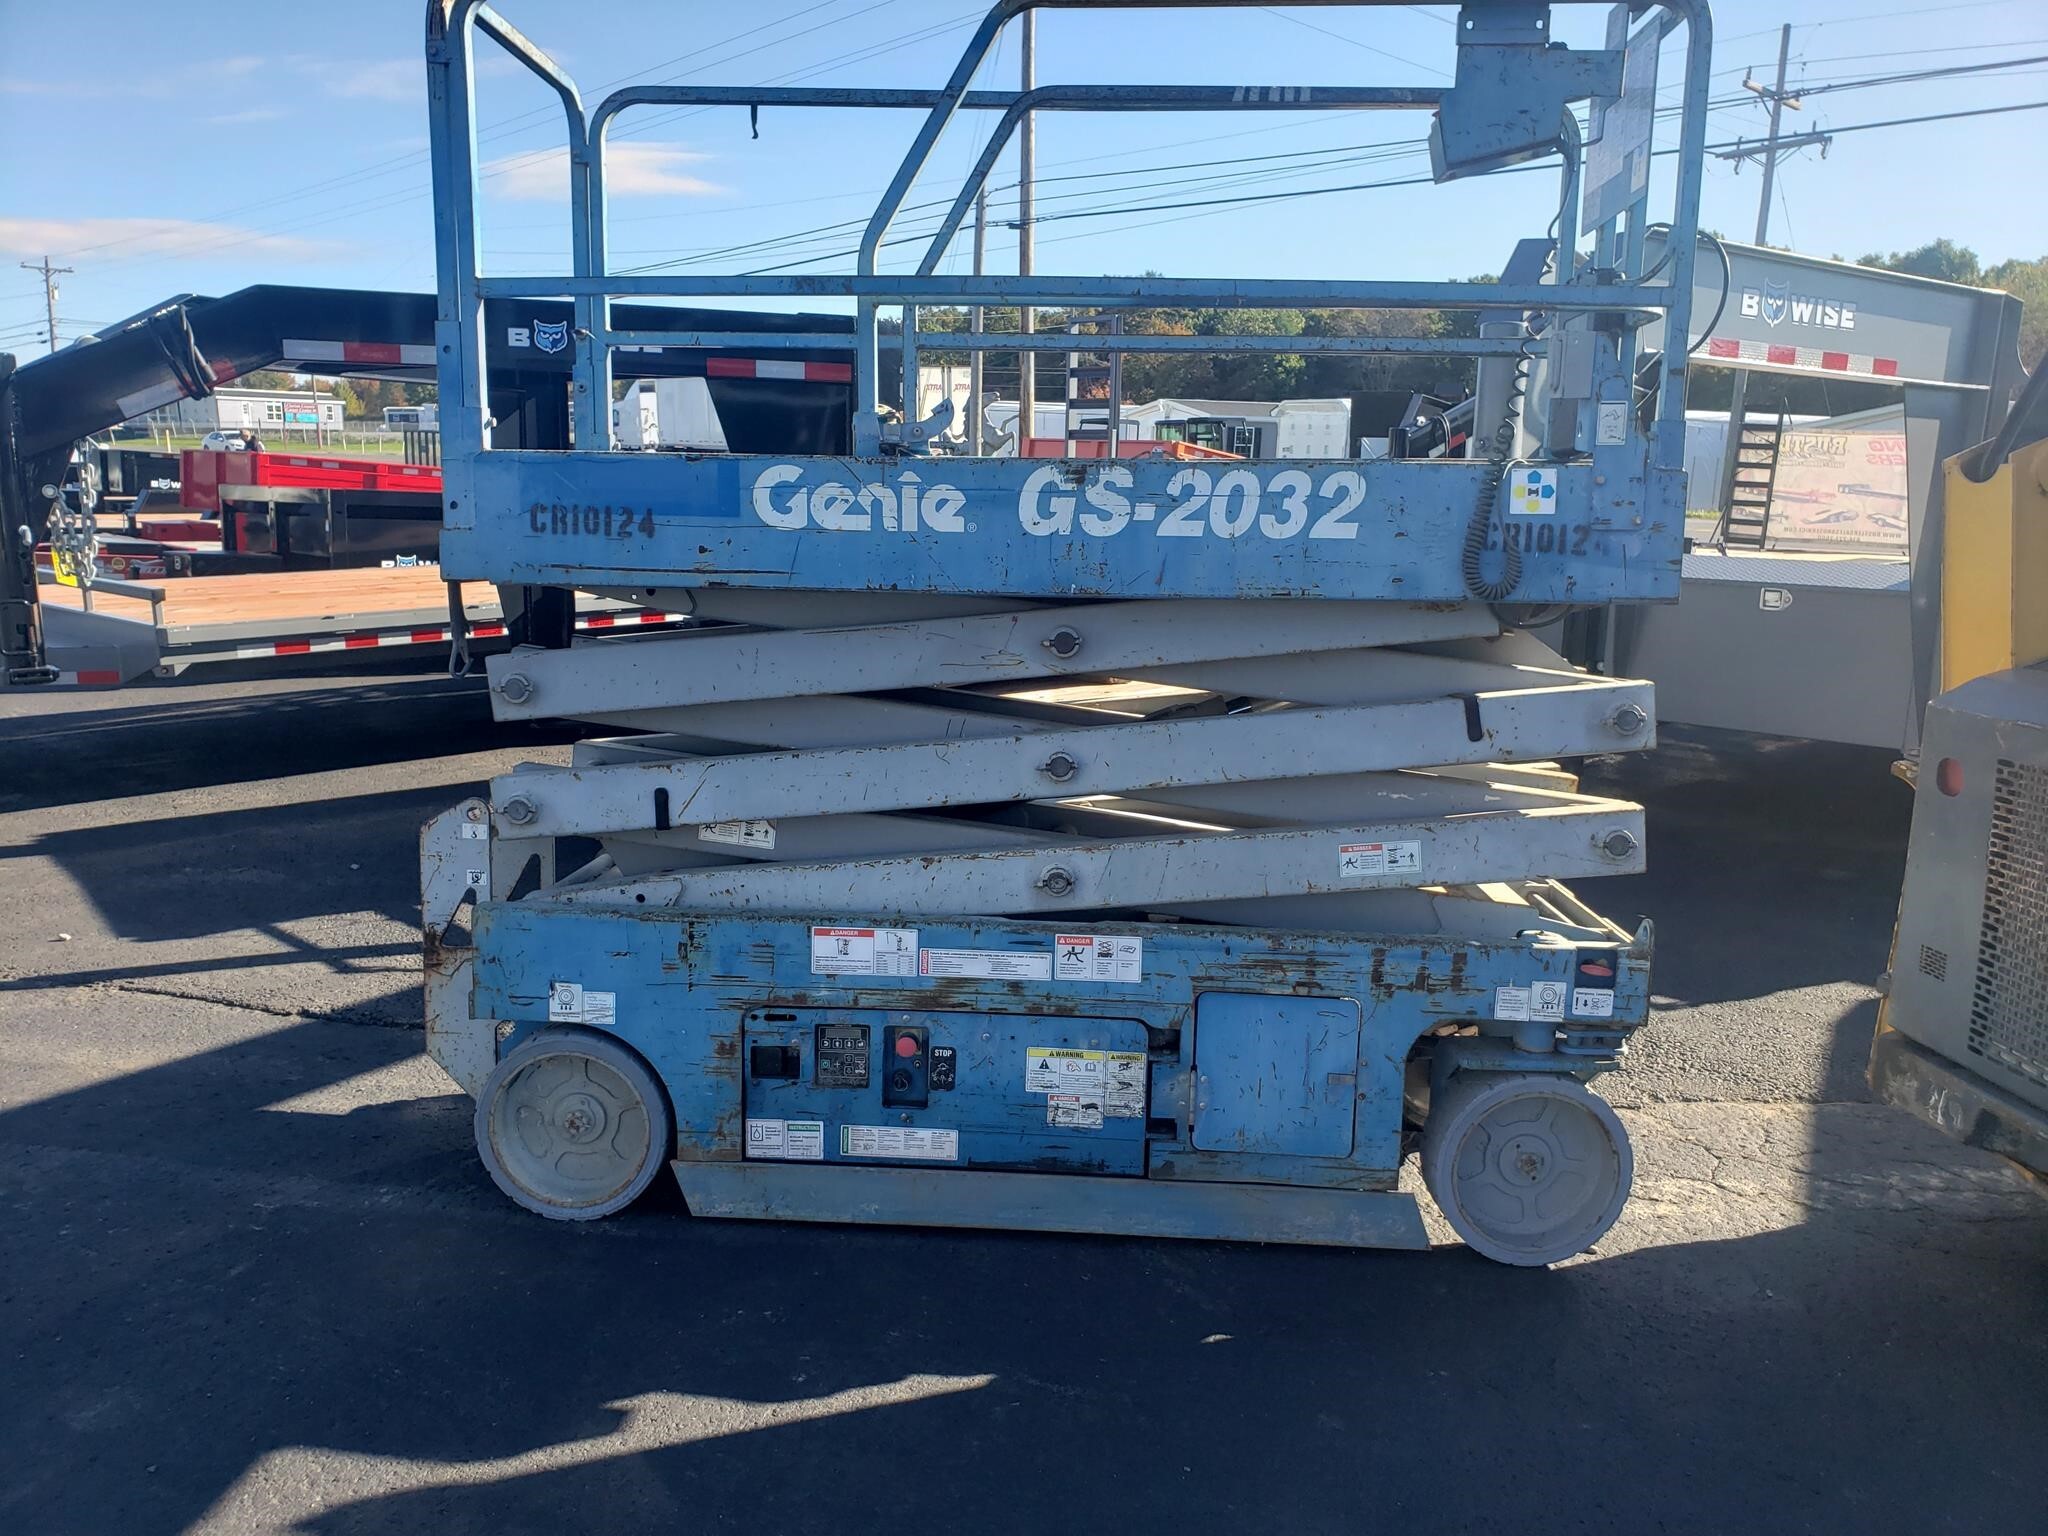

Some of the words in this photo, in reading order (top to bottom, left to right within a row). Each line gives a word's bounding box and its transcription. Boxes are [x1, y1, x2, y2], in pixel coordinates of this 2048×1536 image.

[752, 464, 966, 533] Genie
[1018, 465, 1366, 541] GS-2032
[529, 503, 657, 539] CR10124
[835, 929, 859, 937] DANGER
[1066, 937, 1091, 945] DANGER
[934, 1048, 953, 1057] STOP
[1055, 1050, 1084, 1059] WARNING
